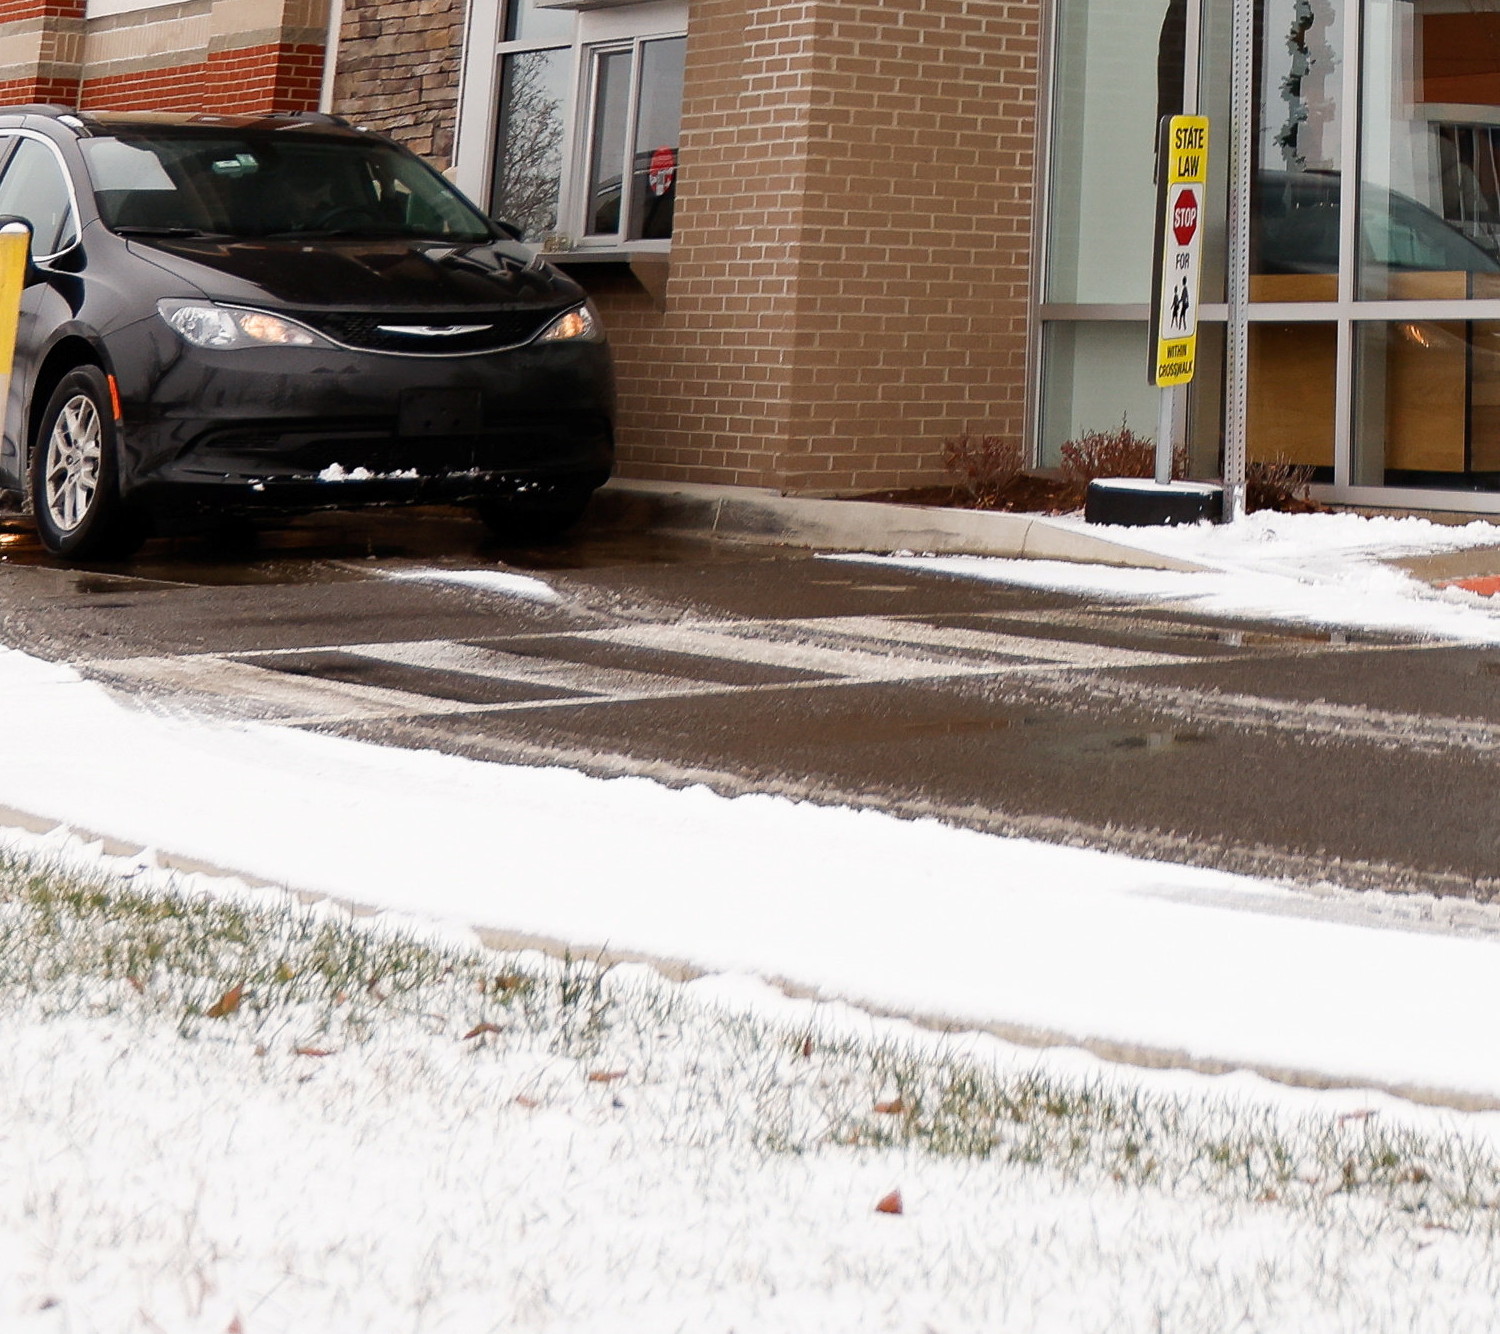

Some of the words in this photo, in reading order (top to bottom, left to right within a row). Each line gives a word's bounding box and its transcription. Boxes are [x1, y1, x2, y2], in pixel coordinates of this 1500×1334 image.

[1174, 128, 1204, 150] STATE
[1177, 155, 1201, 178] LAW
[1174, 206, 1197, 229] STOP
[1175, 252, 1190, 271] FOR
[1167, 344, 1188, 360] WITHIN
[1158, 359, 1194, 379] CROSSWALK
